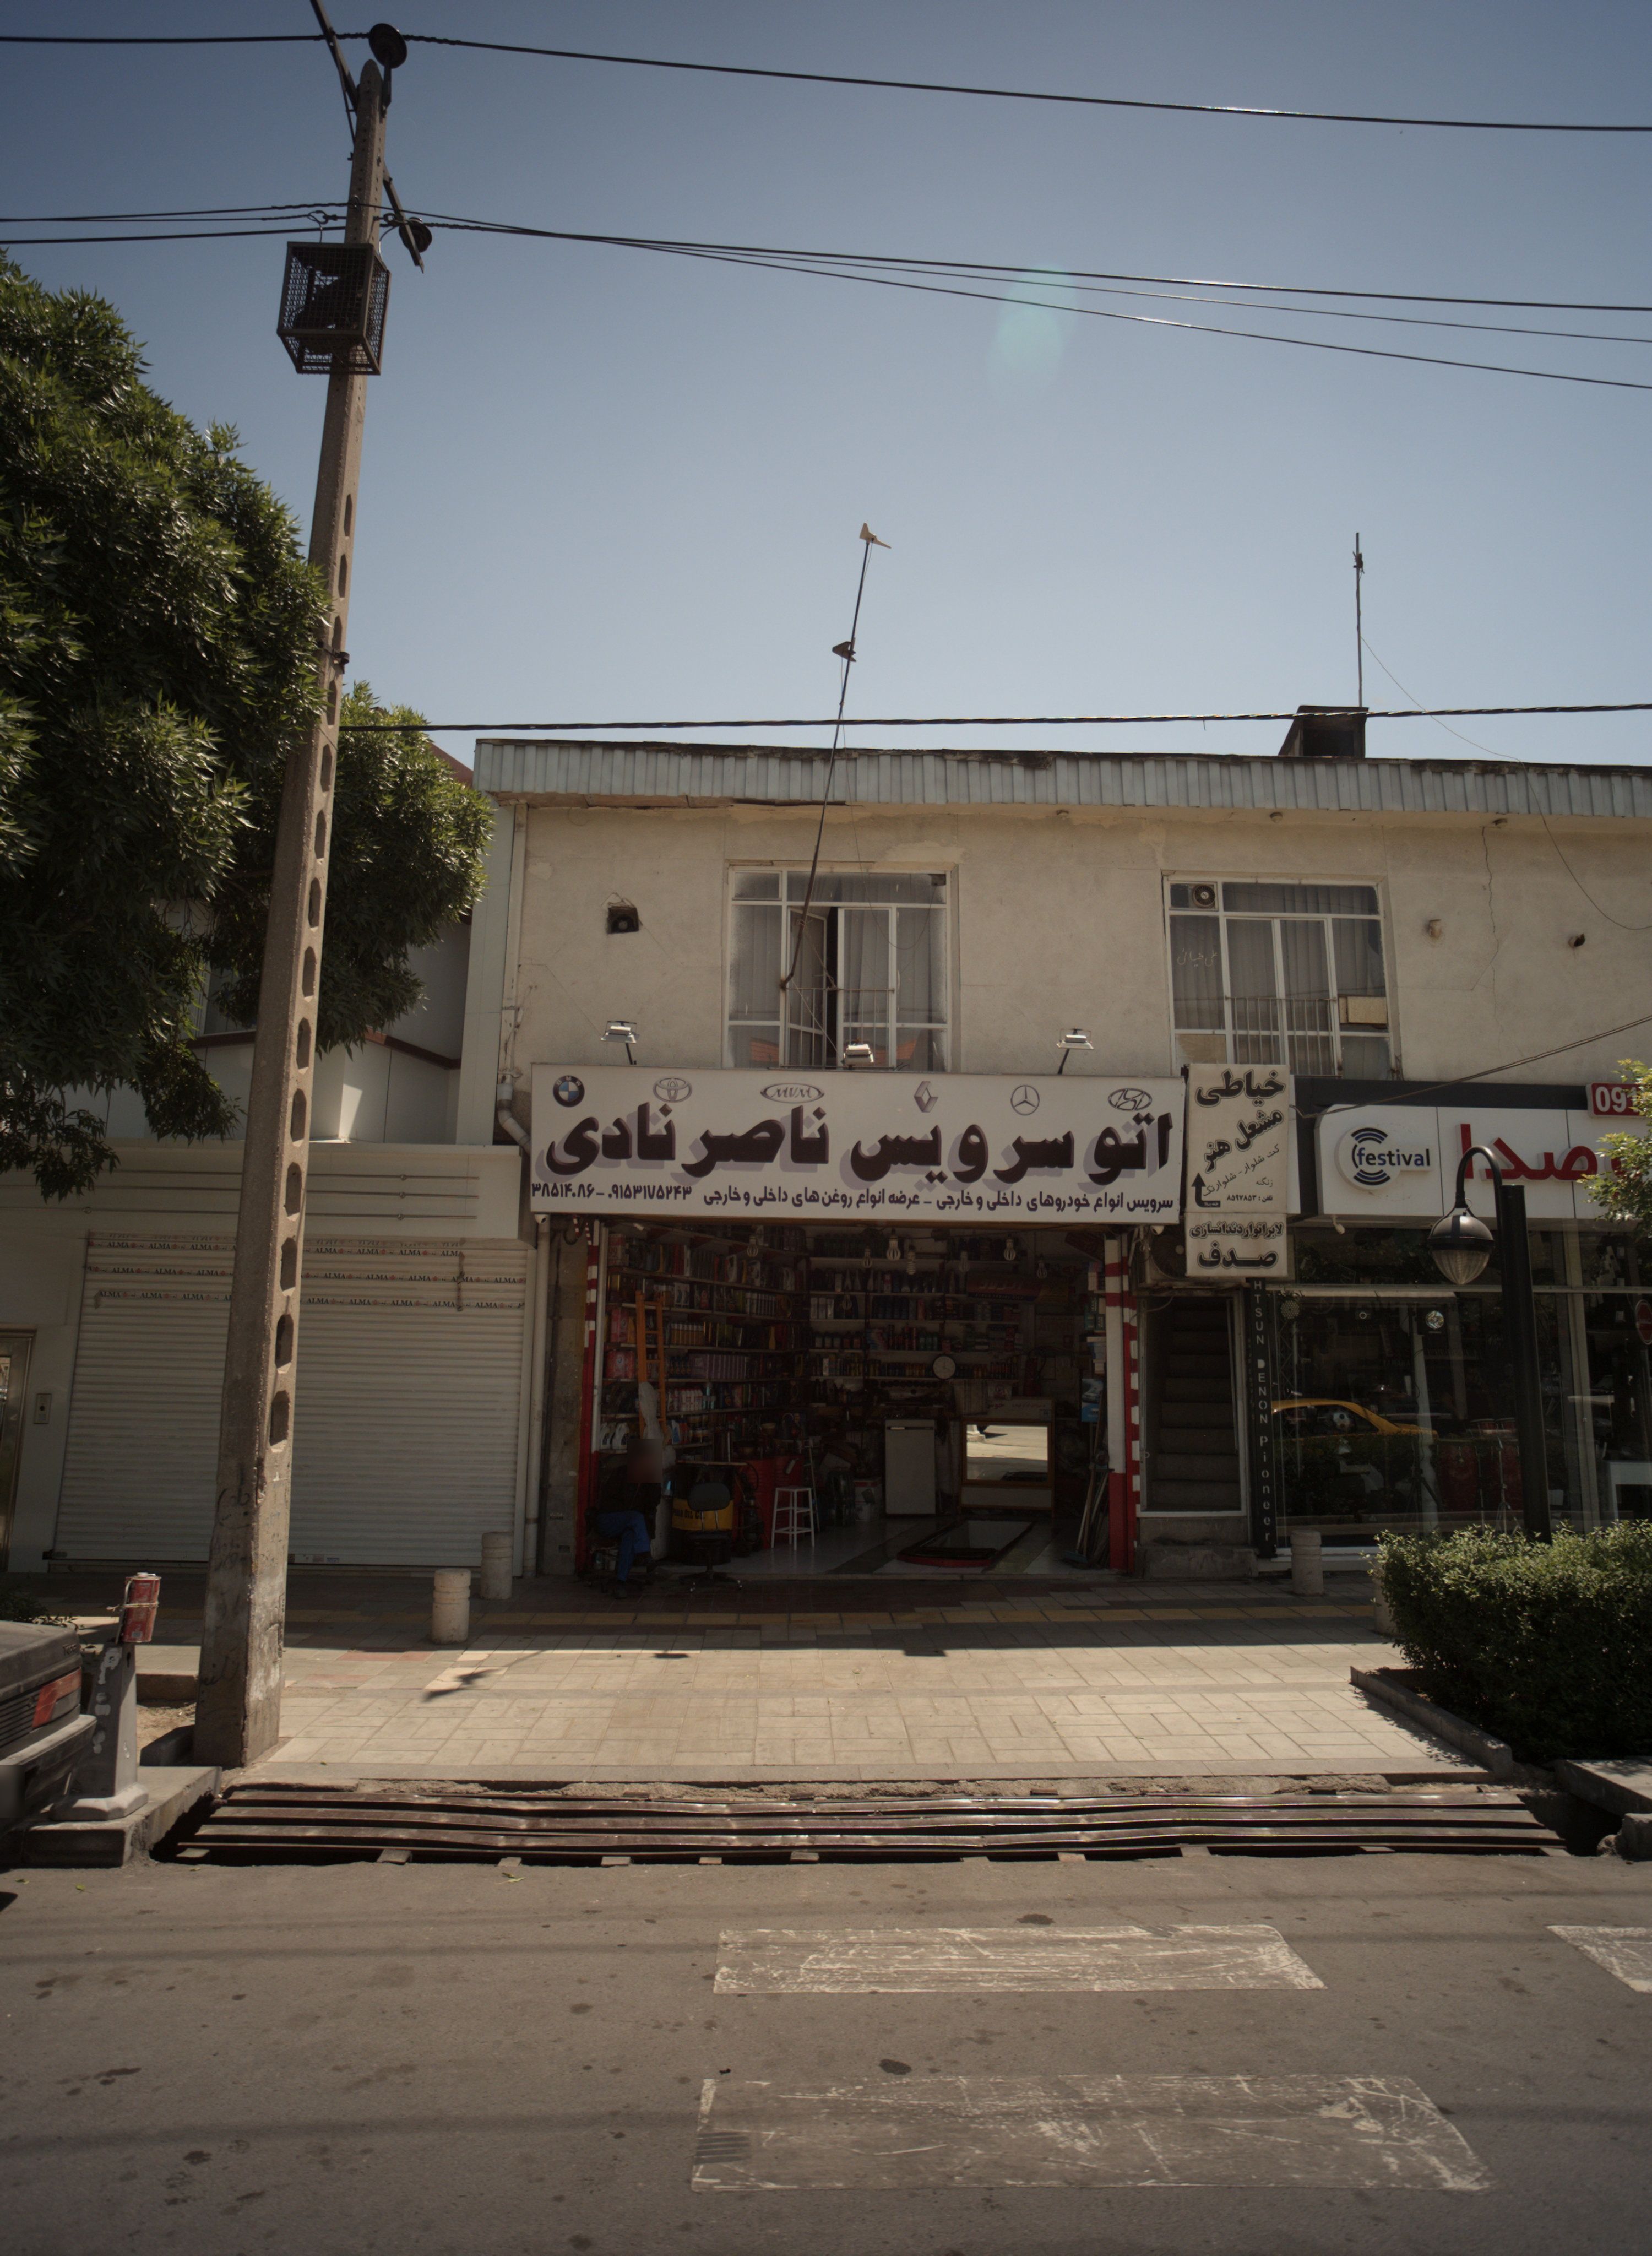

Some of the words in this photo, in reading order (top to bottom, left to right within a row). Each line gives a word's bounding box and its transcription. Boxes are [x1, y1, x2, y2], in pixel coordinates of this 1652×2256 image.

[773, 1087, 812, 1097] MVM
[1195, 1068, 1286, 1108] خیاطی
[546, 1102, 676, 1175] نادی
[681, 1105, 829, 1178] ناصر
[1235, 1110, 1284, 1152] مشعل
[1204, 1139, 1232, 1174] هنر
[1245, 1155, 1265, 1174] شلوار
[1357, 1148, 1430, 1167] festival
[704, 1185, 741, 1206] خارجی
[743, 1191, 750, 1207] و
[753, 1186, 788, 1206] داخلی
[856, 1188, 885, 1209] انواع
[888, 1191, 920, 1210] عرضه
[936, 1190, 974, 1211] خارجی
[976, 1196, 983, 1211] و
[987, 1190, 1022, 1211] داخلی
[1094, 1192, 1123, 1212] انواع
[1127, 1198, 1173, 1213] سرویس
[1197, 1240, 1278, 1269] صدف
[1257, 1358, 1268, 1424] DENON
